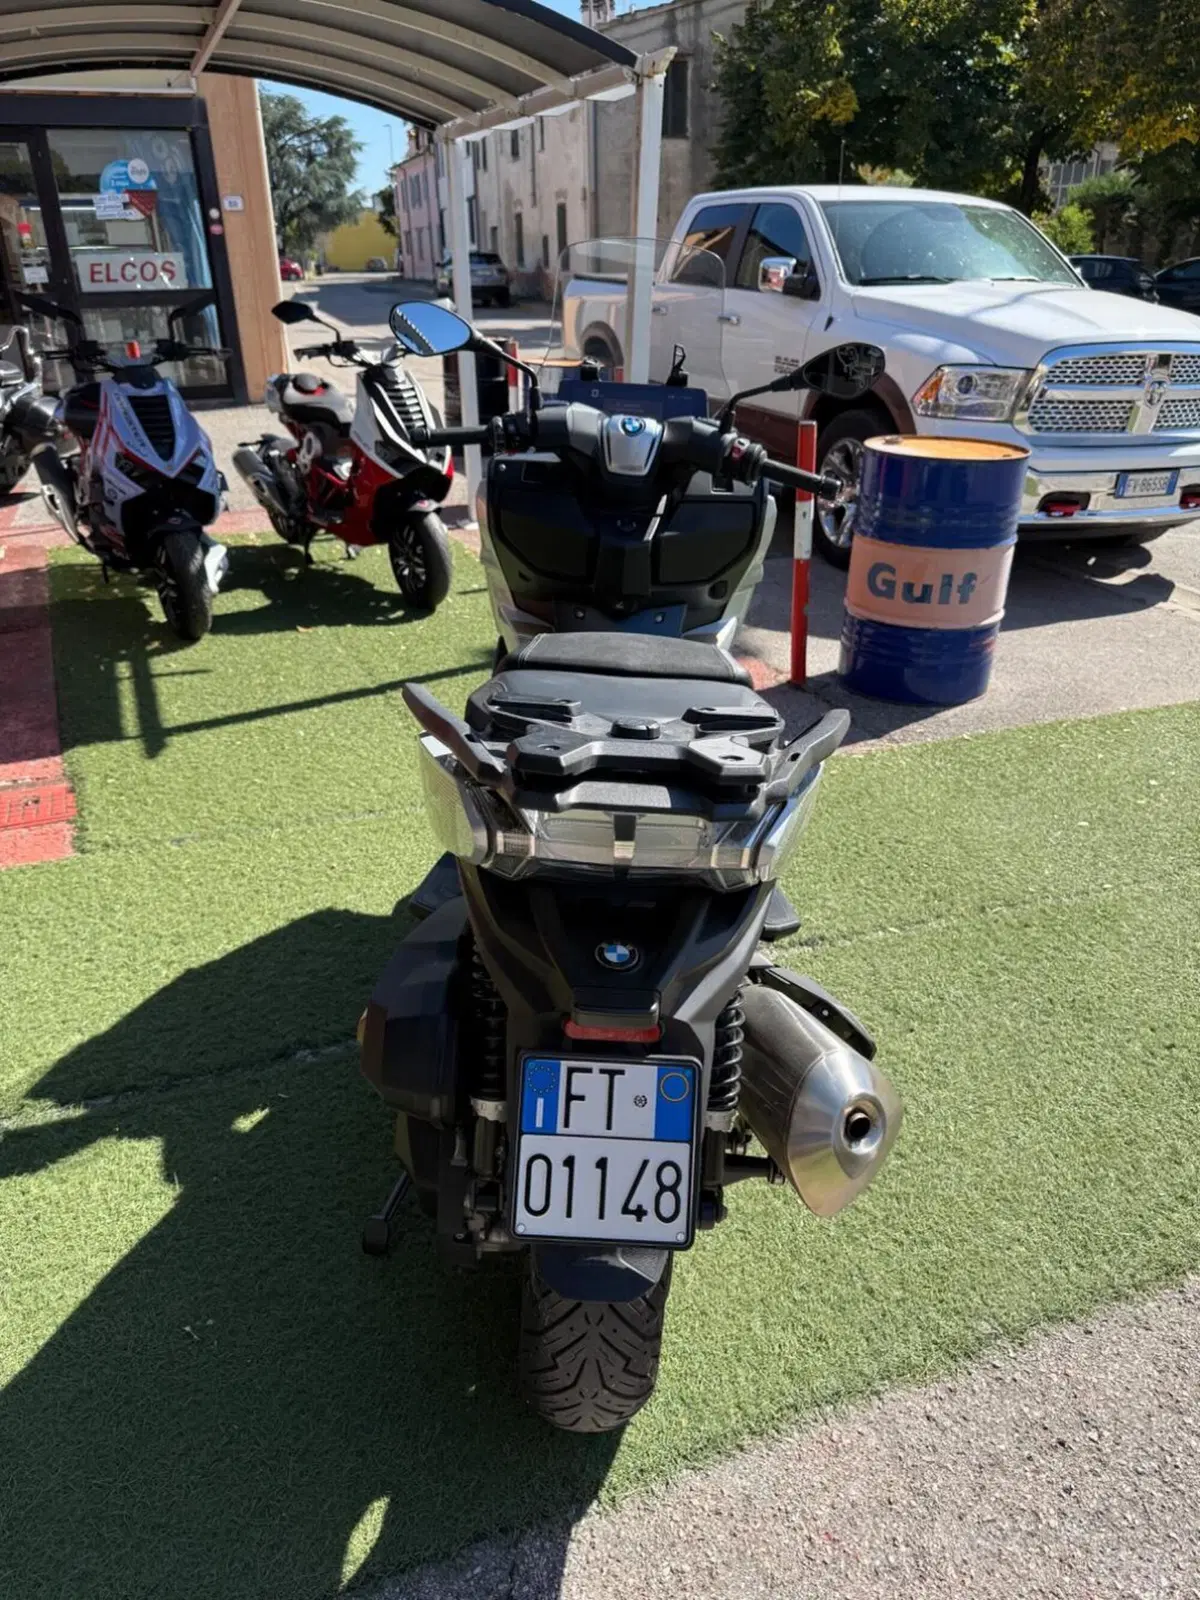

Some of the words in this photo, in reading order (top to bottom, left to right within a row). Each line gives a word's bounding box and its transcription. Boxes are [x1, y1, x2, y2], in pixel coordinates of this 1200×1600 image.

[89, 260, 176, 283] ELCOS
[867, 562, 978, 604] Gulf
[563, 1066, 625, 1131] FT
[524, 1153, 682, 1224] 01148
